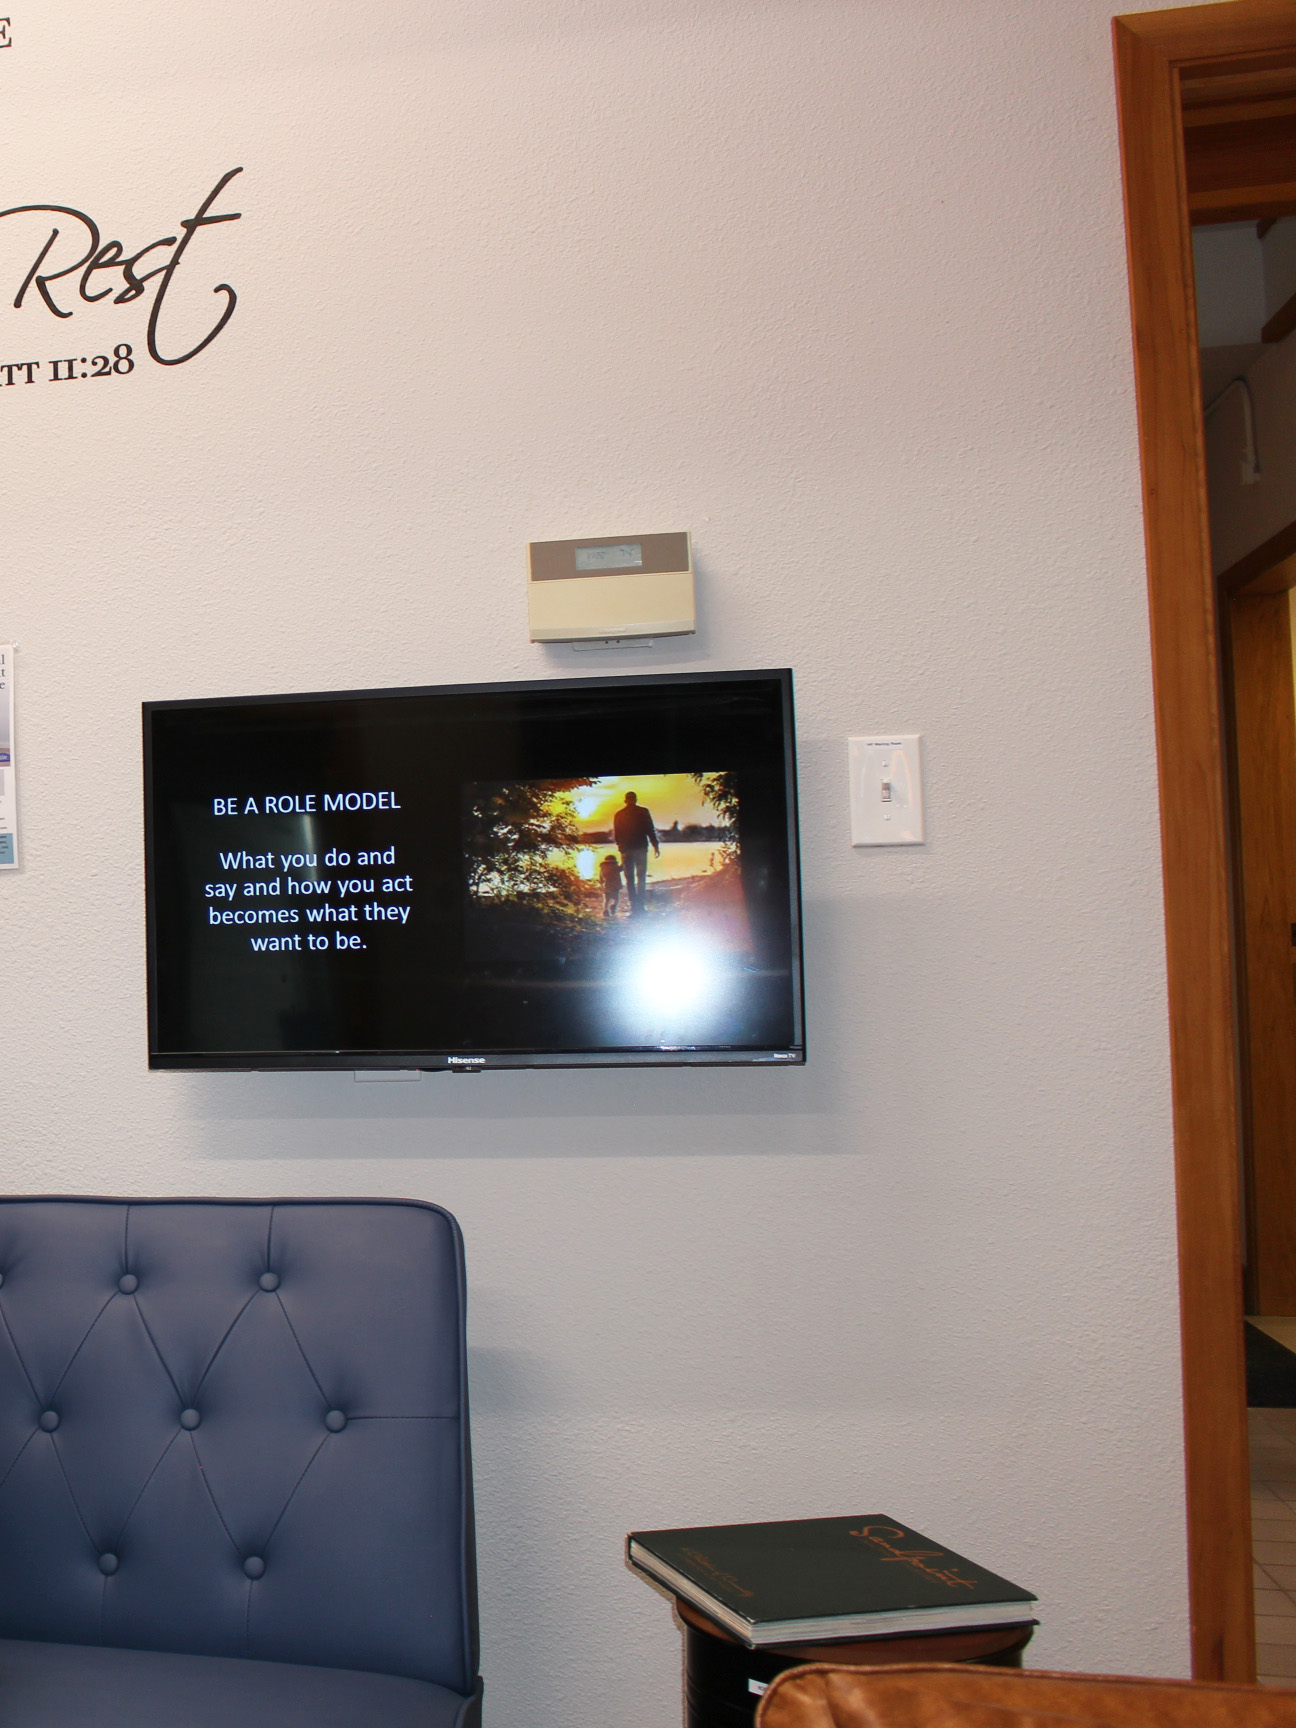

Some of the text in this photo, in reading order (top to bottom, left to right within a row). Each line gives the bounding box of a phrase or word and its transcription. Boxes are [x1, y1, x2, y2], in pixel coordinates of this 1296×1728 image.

[213, 791, 402, 816] BE A ROLE MODEL
[219, 845, 395, 872] What you do and
[205, 874, 414, 901] say and how you act
[209, 901, 411, 925] becomes what they
[250, 930, 367, 951] want to be.
[447, 1056, 486, 1064] Hisense
